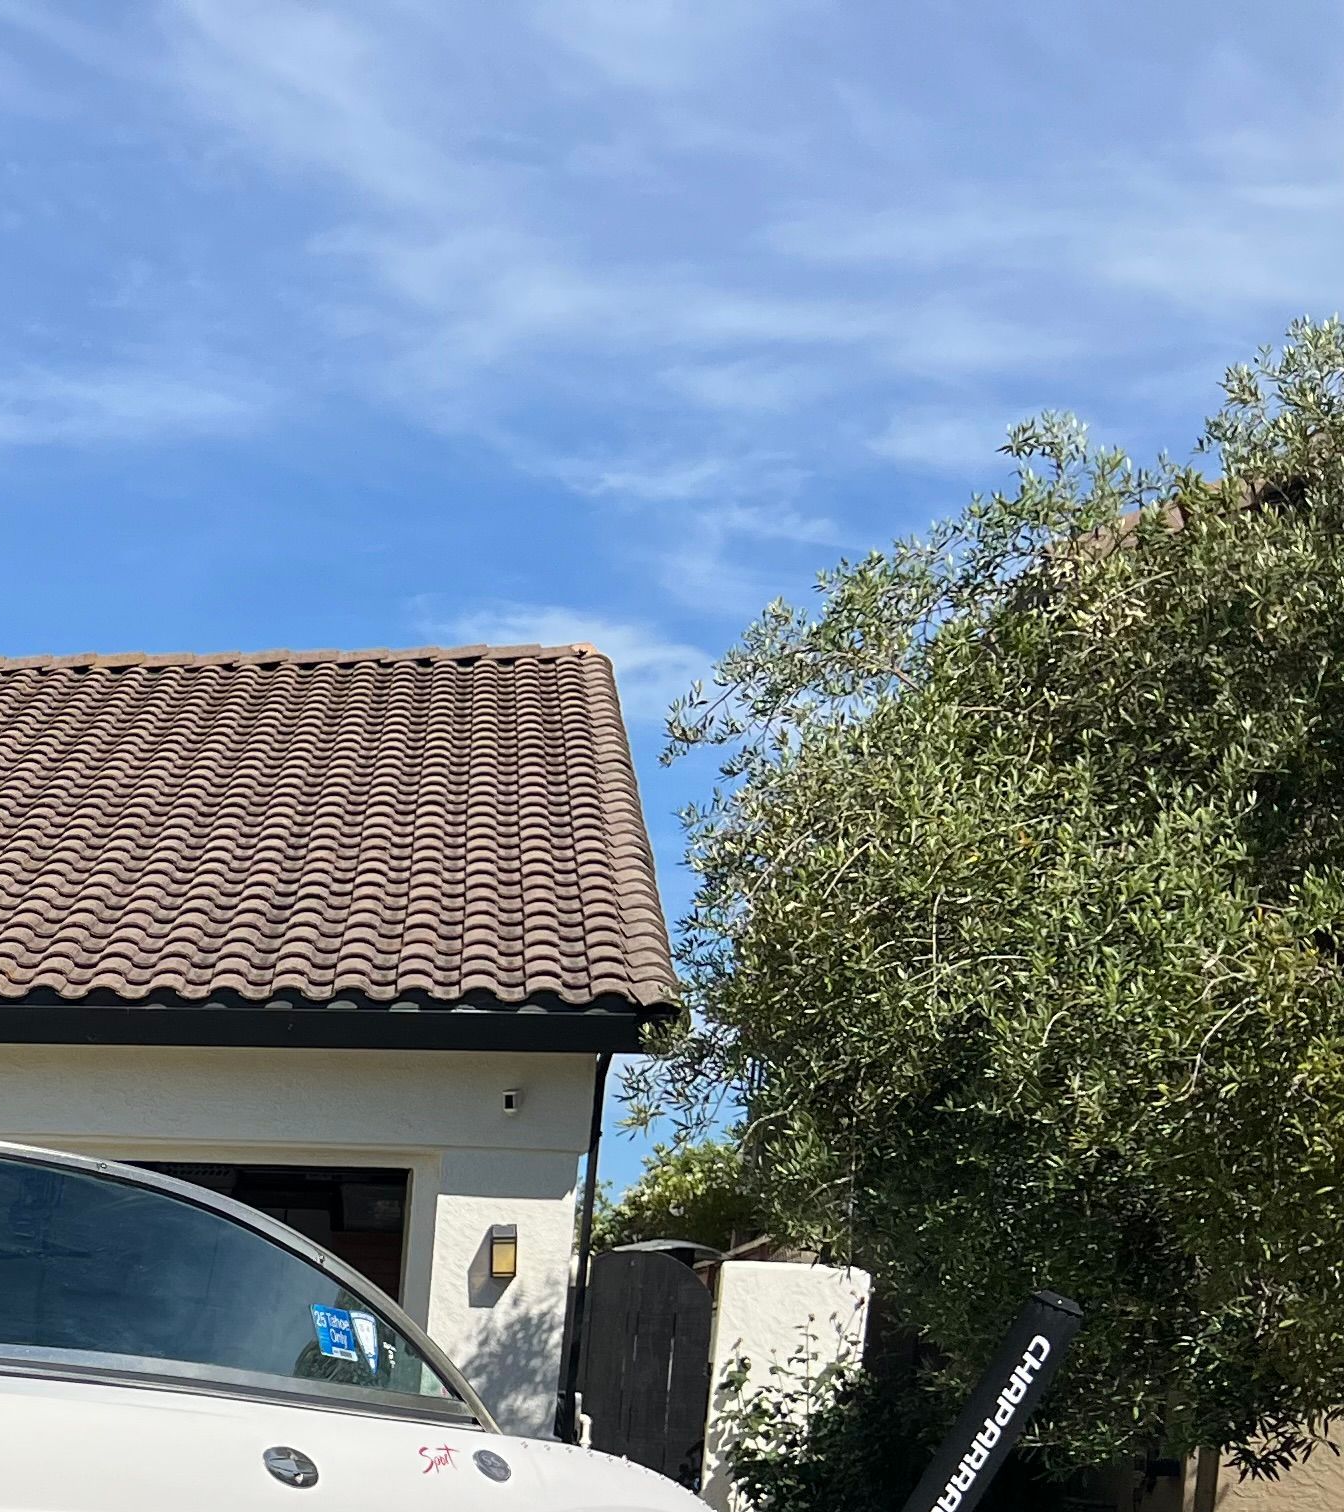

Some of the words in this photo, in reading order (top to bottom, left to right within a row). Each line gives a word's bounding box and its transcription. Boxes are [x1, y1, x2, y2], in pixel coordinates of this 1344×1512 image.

[314, 1311, 327, 1328] 25
[326, 1312, 350, 1331] Tahoe
[330, 1328, 348, 1349] Only
[418, 1444, 460, 1474] Sport
